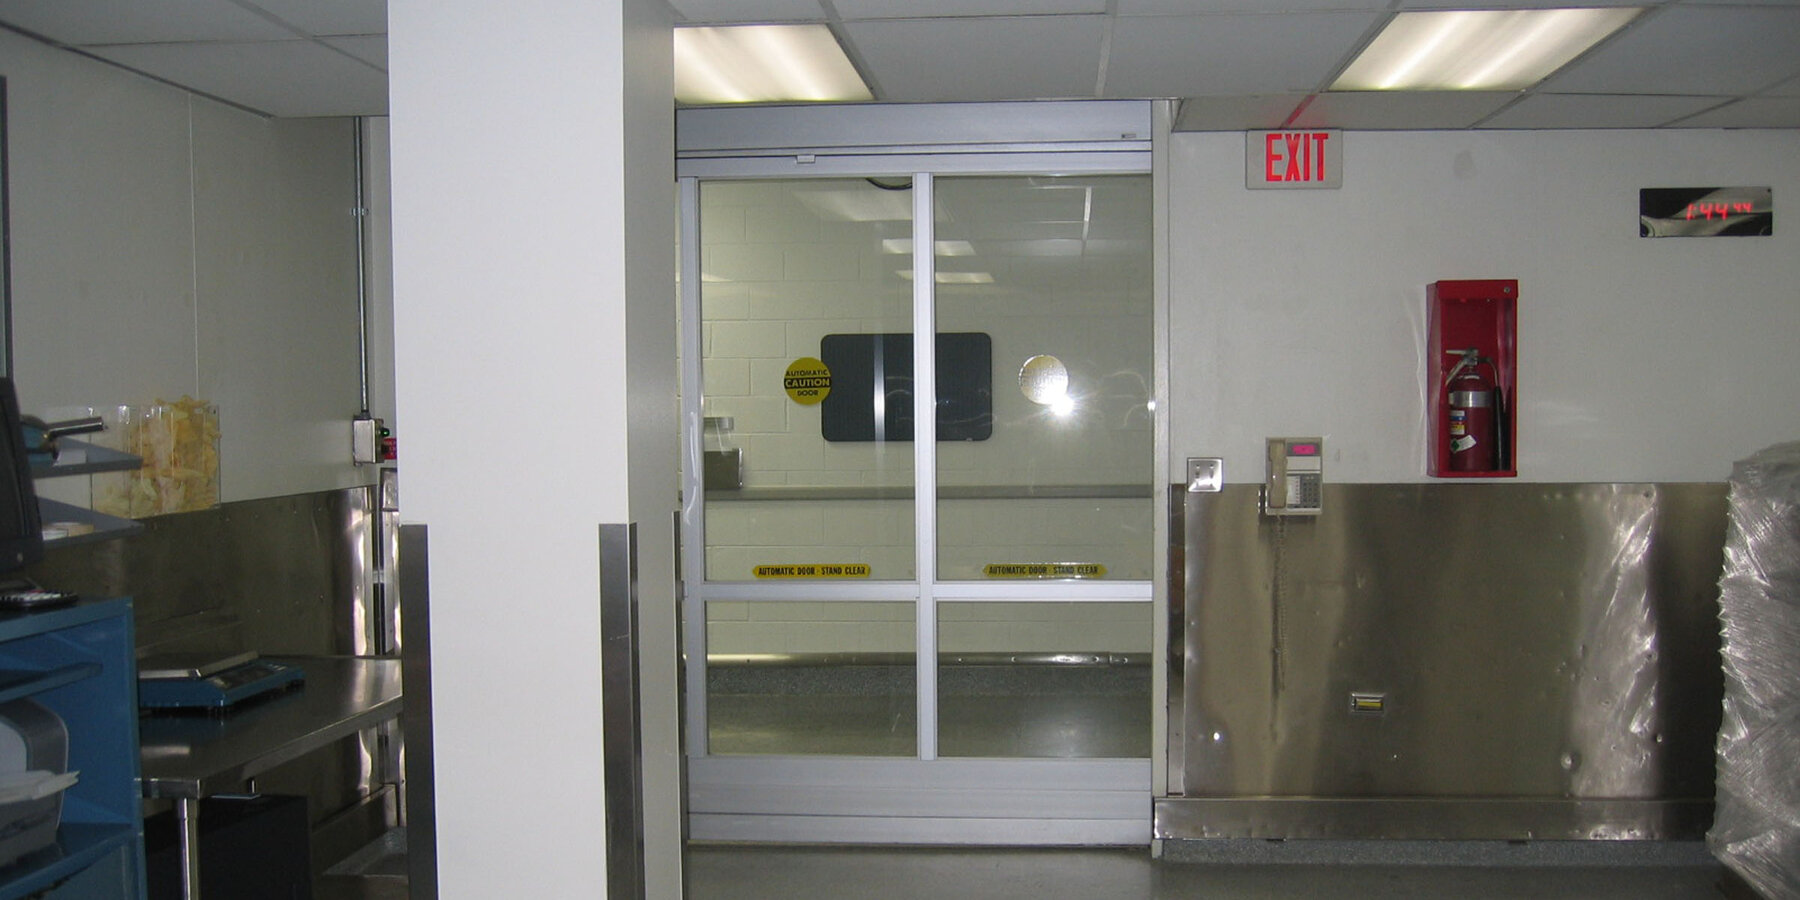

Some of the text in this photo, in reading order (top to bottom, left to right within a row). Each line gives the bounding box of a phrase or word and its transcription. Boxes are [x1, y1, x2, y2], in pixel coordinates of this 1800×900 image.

[1265, 133, 1329, 182] EXIT
[785, 369, 829, 377] AUTOMATIC
[785, 378, 830, 388] CAUTION
[758, 566, 866, 576] AUTOMATIC DOOR STAND CLEAR
[988, 565, 1099, 575] AUTOMATIC DOOR STAND CLEAR
